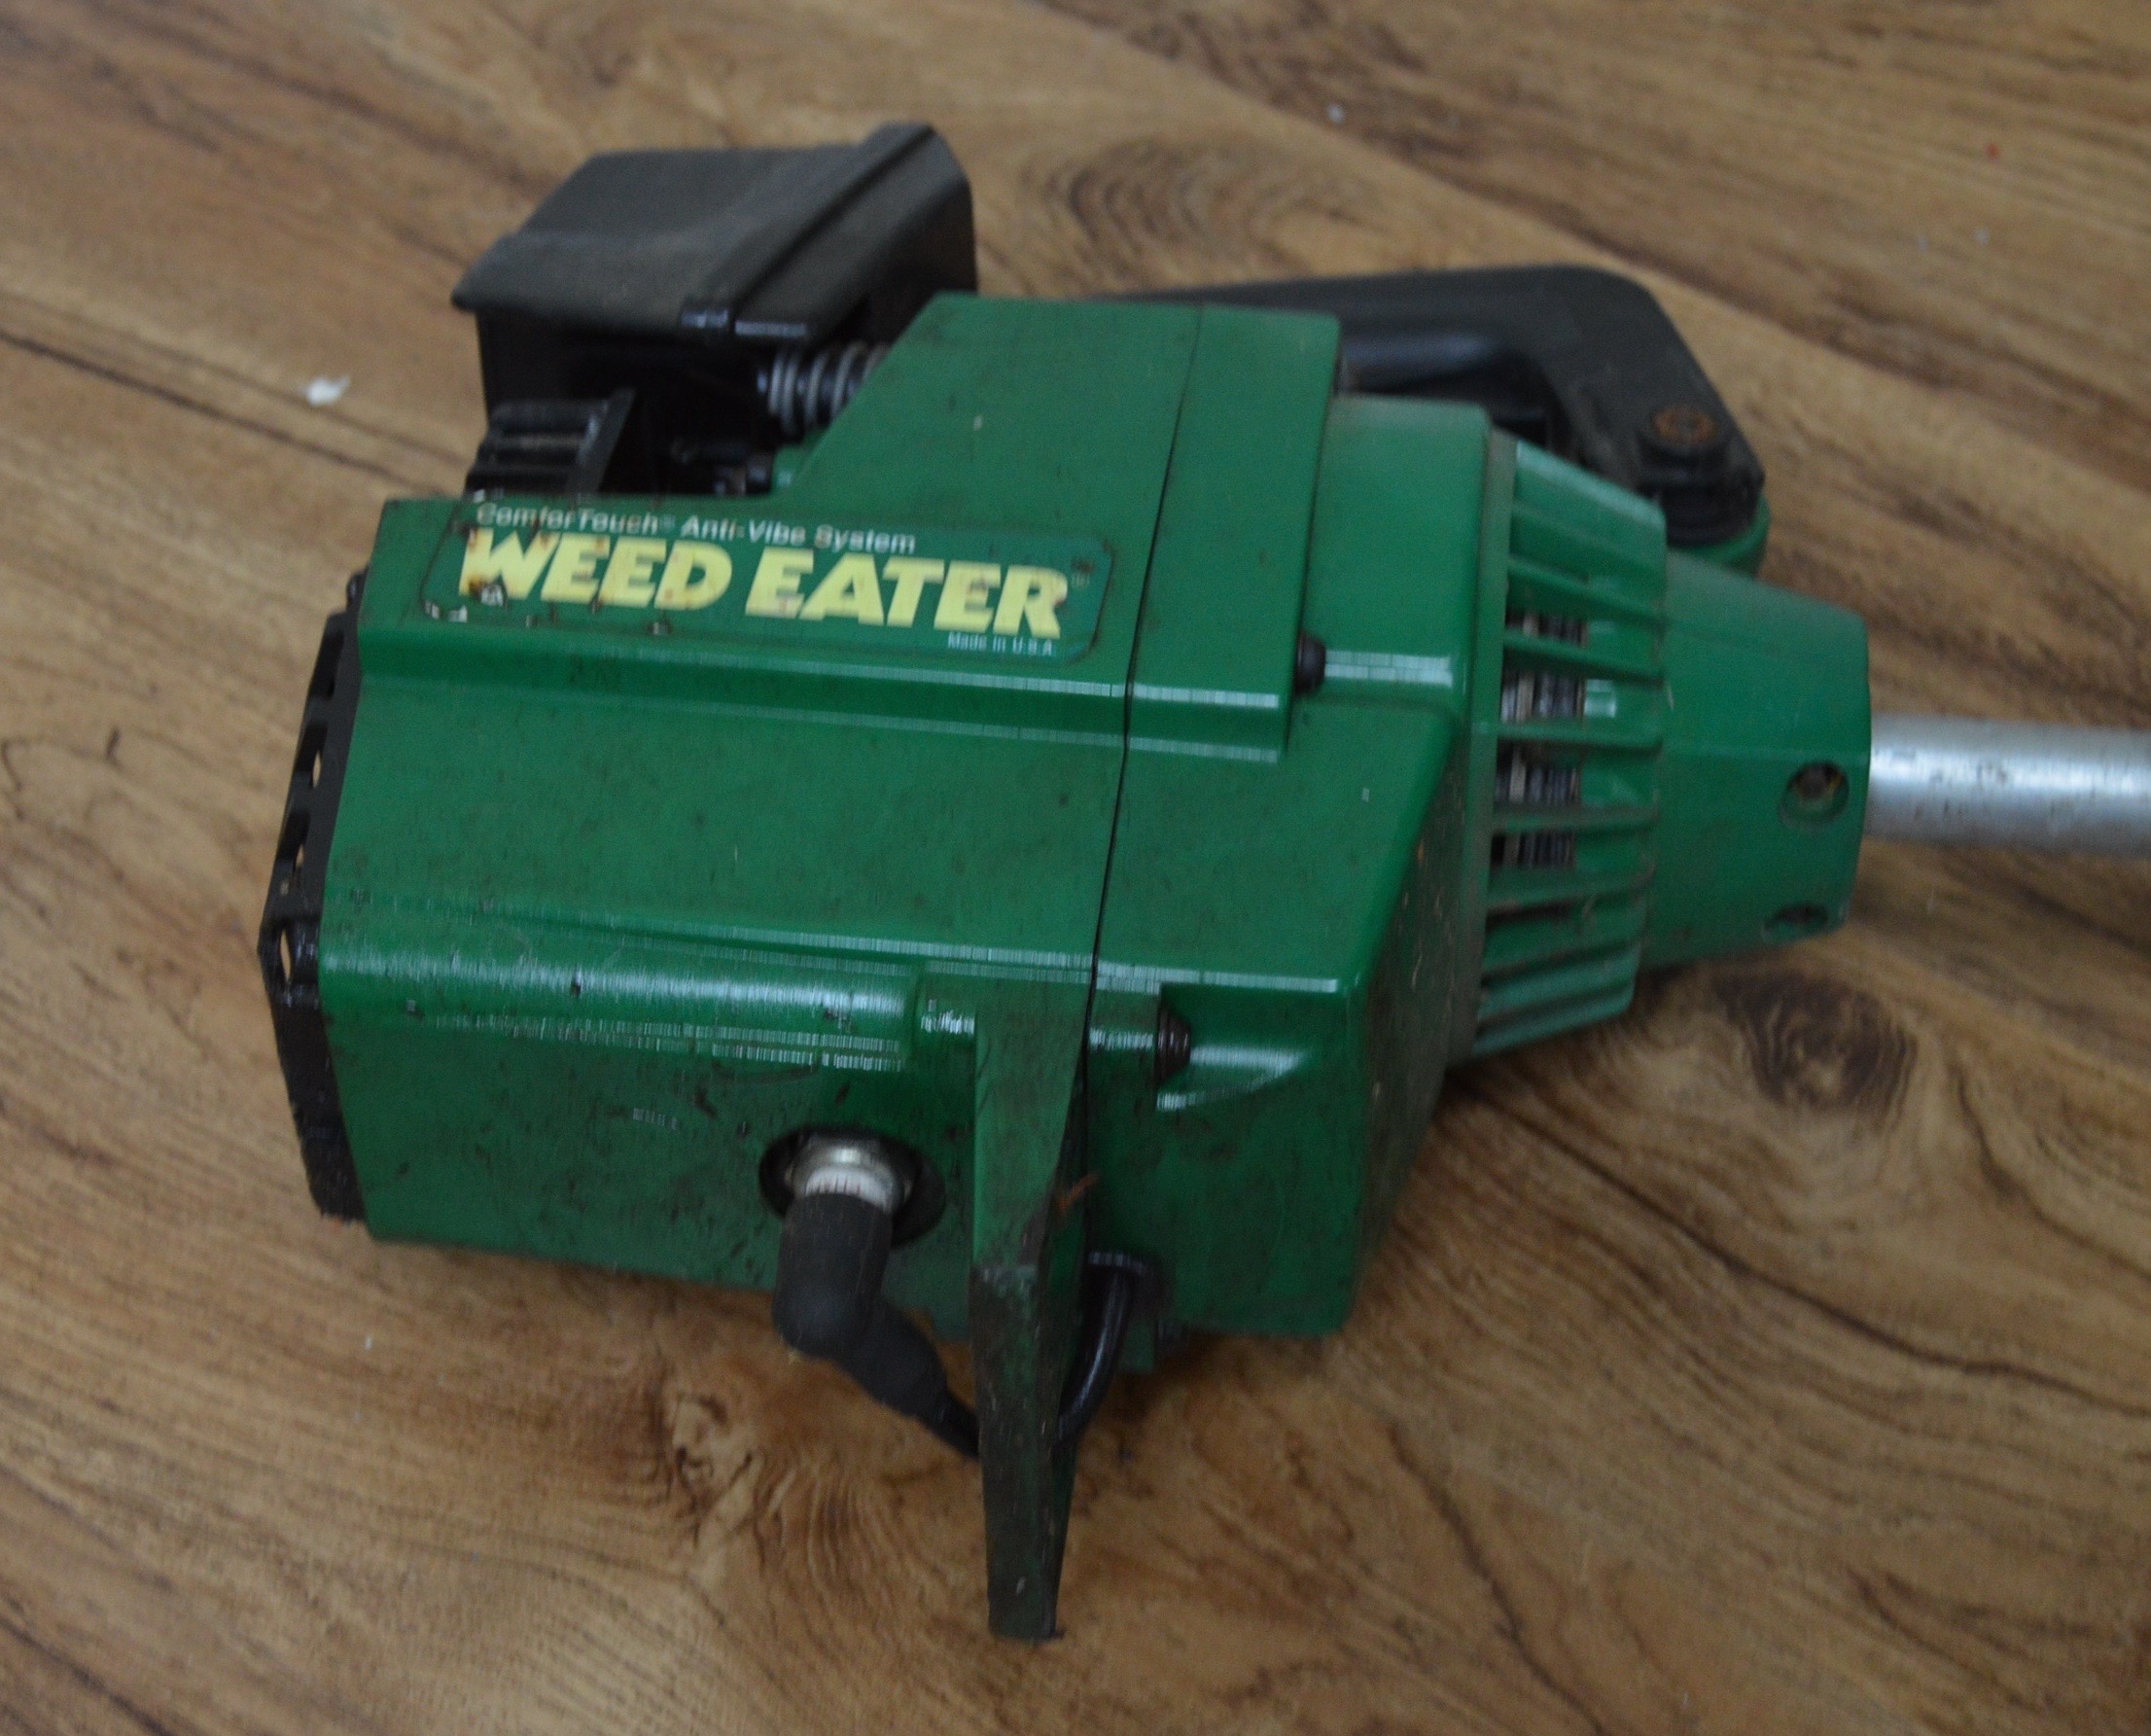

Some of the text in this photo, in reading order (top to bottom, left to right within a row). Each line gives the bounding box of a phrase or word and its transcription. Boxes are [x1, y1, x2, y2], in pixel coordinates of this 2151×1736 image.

[814, 525, 916, 554] System
[459, 527, 1069, 640] WEED EATER
[948, 631, 987, 652] Made
[993, 634, 1006, 653] in
